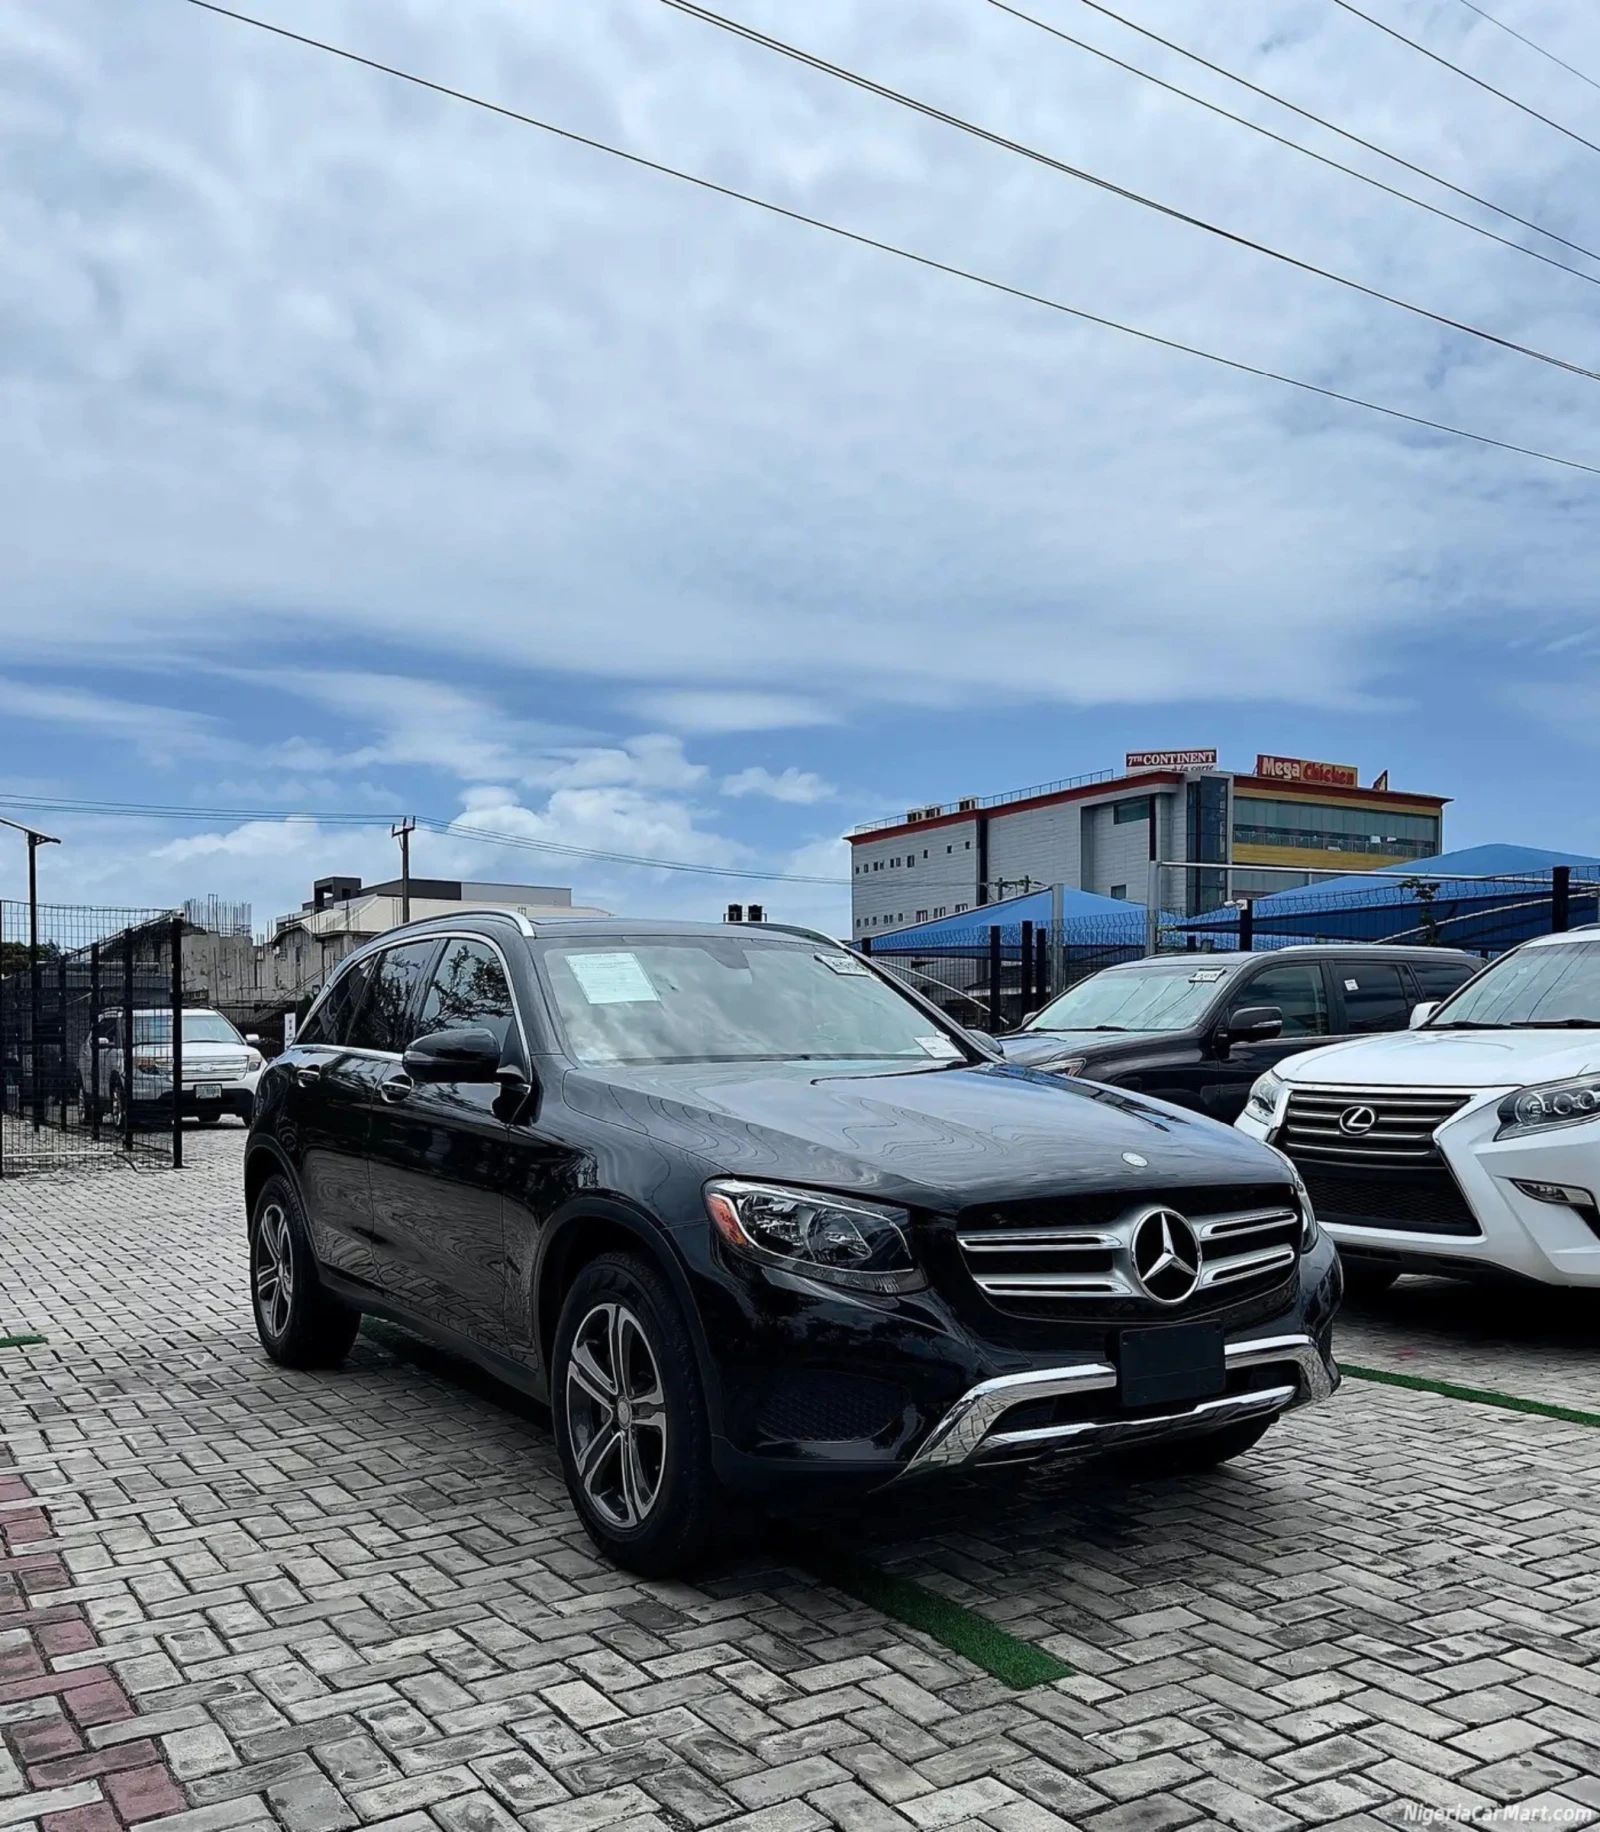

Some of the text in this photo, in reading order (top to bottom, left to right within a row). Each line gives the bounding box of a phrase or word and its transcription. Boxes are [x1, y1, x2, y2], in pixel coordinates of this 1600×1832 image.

[1127, 752, 1215, 766] 7TH CONTINENT
[1262, 757, 1354, 785] Mega Chicken
